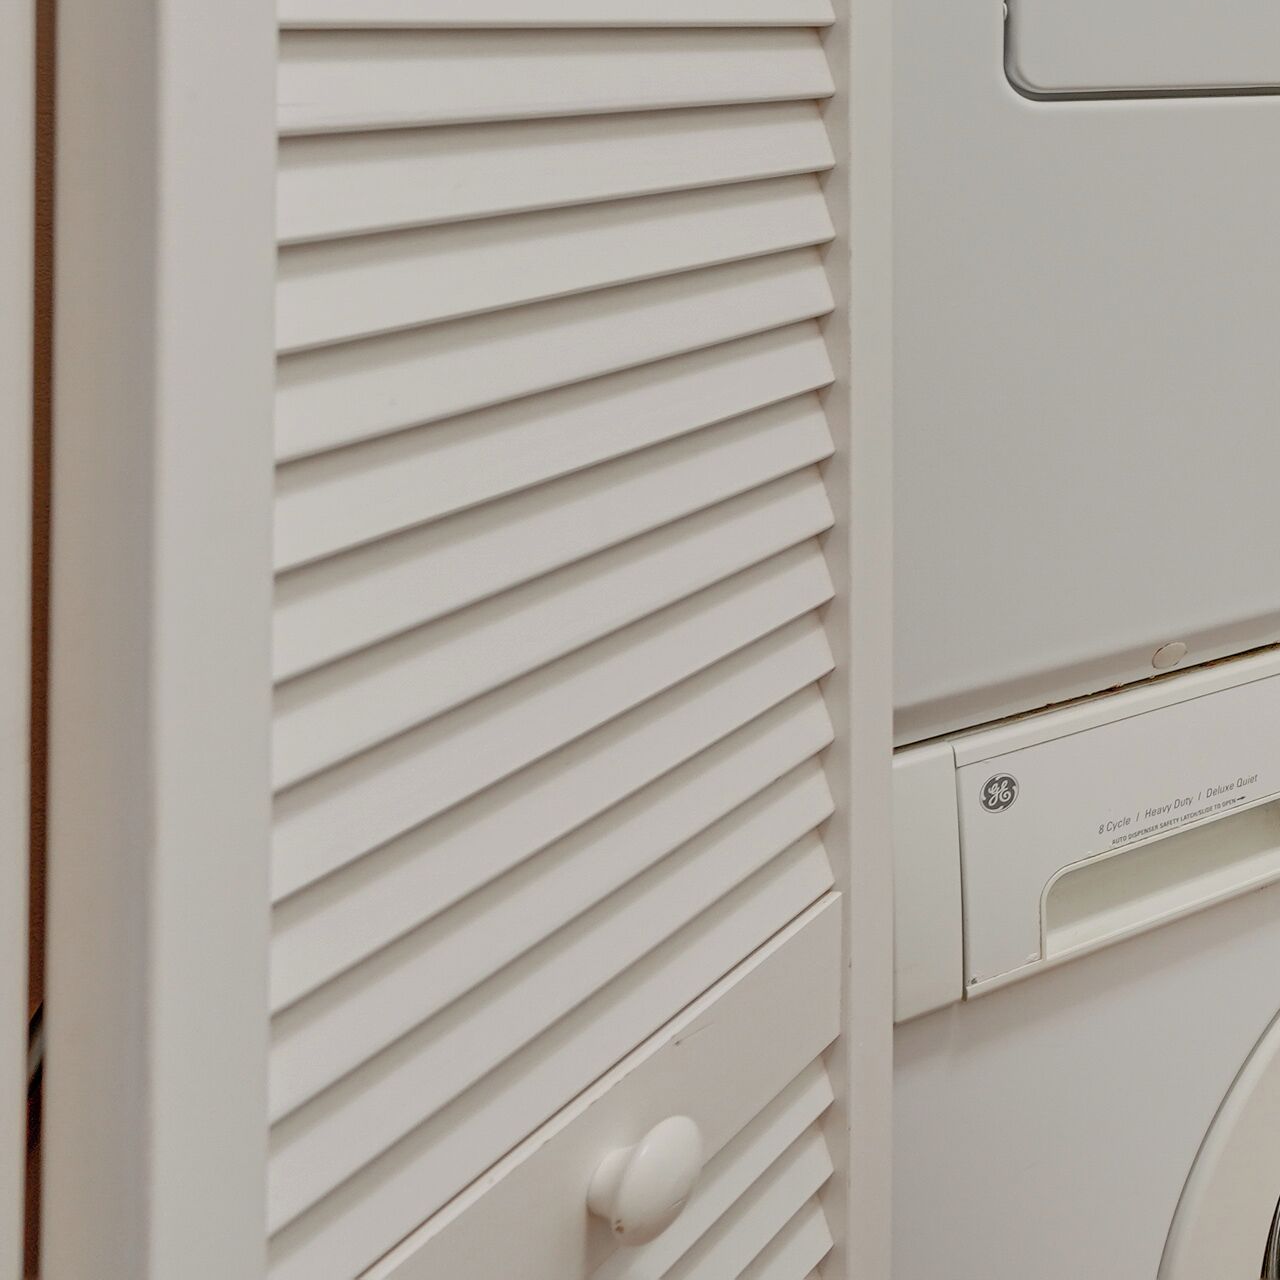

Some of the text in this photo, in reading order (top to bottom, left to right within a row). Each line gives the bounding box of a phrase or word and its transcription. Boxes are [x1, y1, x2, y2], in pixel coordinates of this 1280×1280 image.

[979, 772, 1020, 813] GE
[1097, 823, 1105, 835] 8
[1106, 816, 1132, 833] Cycle
[1144, 804, 1172, 819] Heavy
[1173, 796, 1194, 809] Duty
[1206, 782, 1235, 799] Deluxe
[1236, 773, 1259, 788] Quiet
[1111, 835, 1128, 846] AUTO
[1128, 825, 1159, 840] DISPENSER
[1159, 817, 1180, 831] SAFETY
[1214, 802, 1222, 811] TO
[1222, 798, 1237, 808] OPEN
